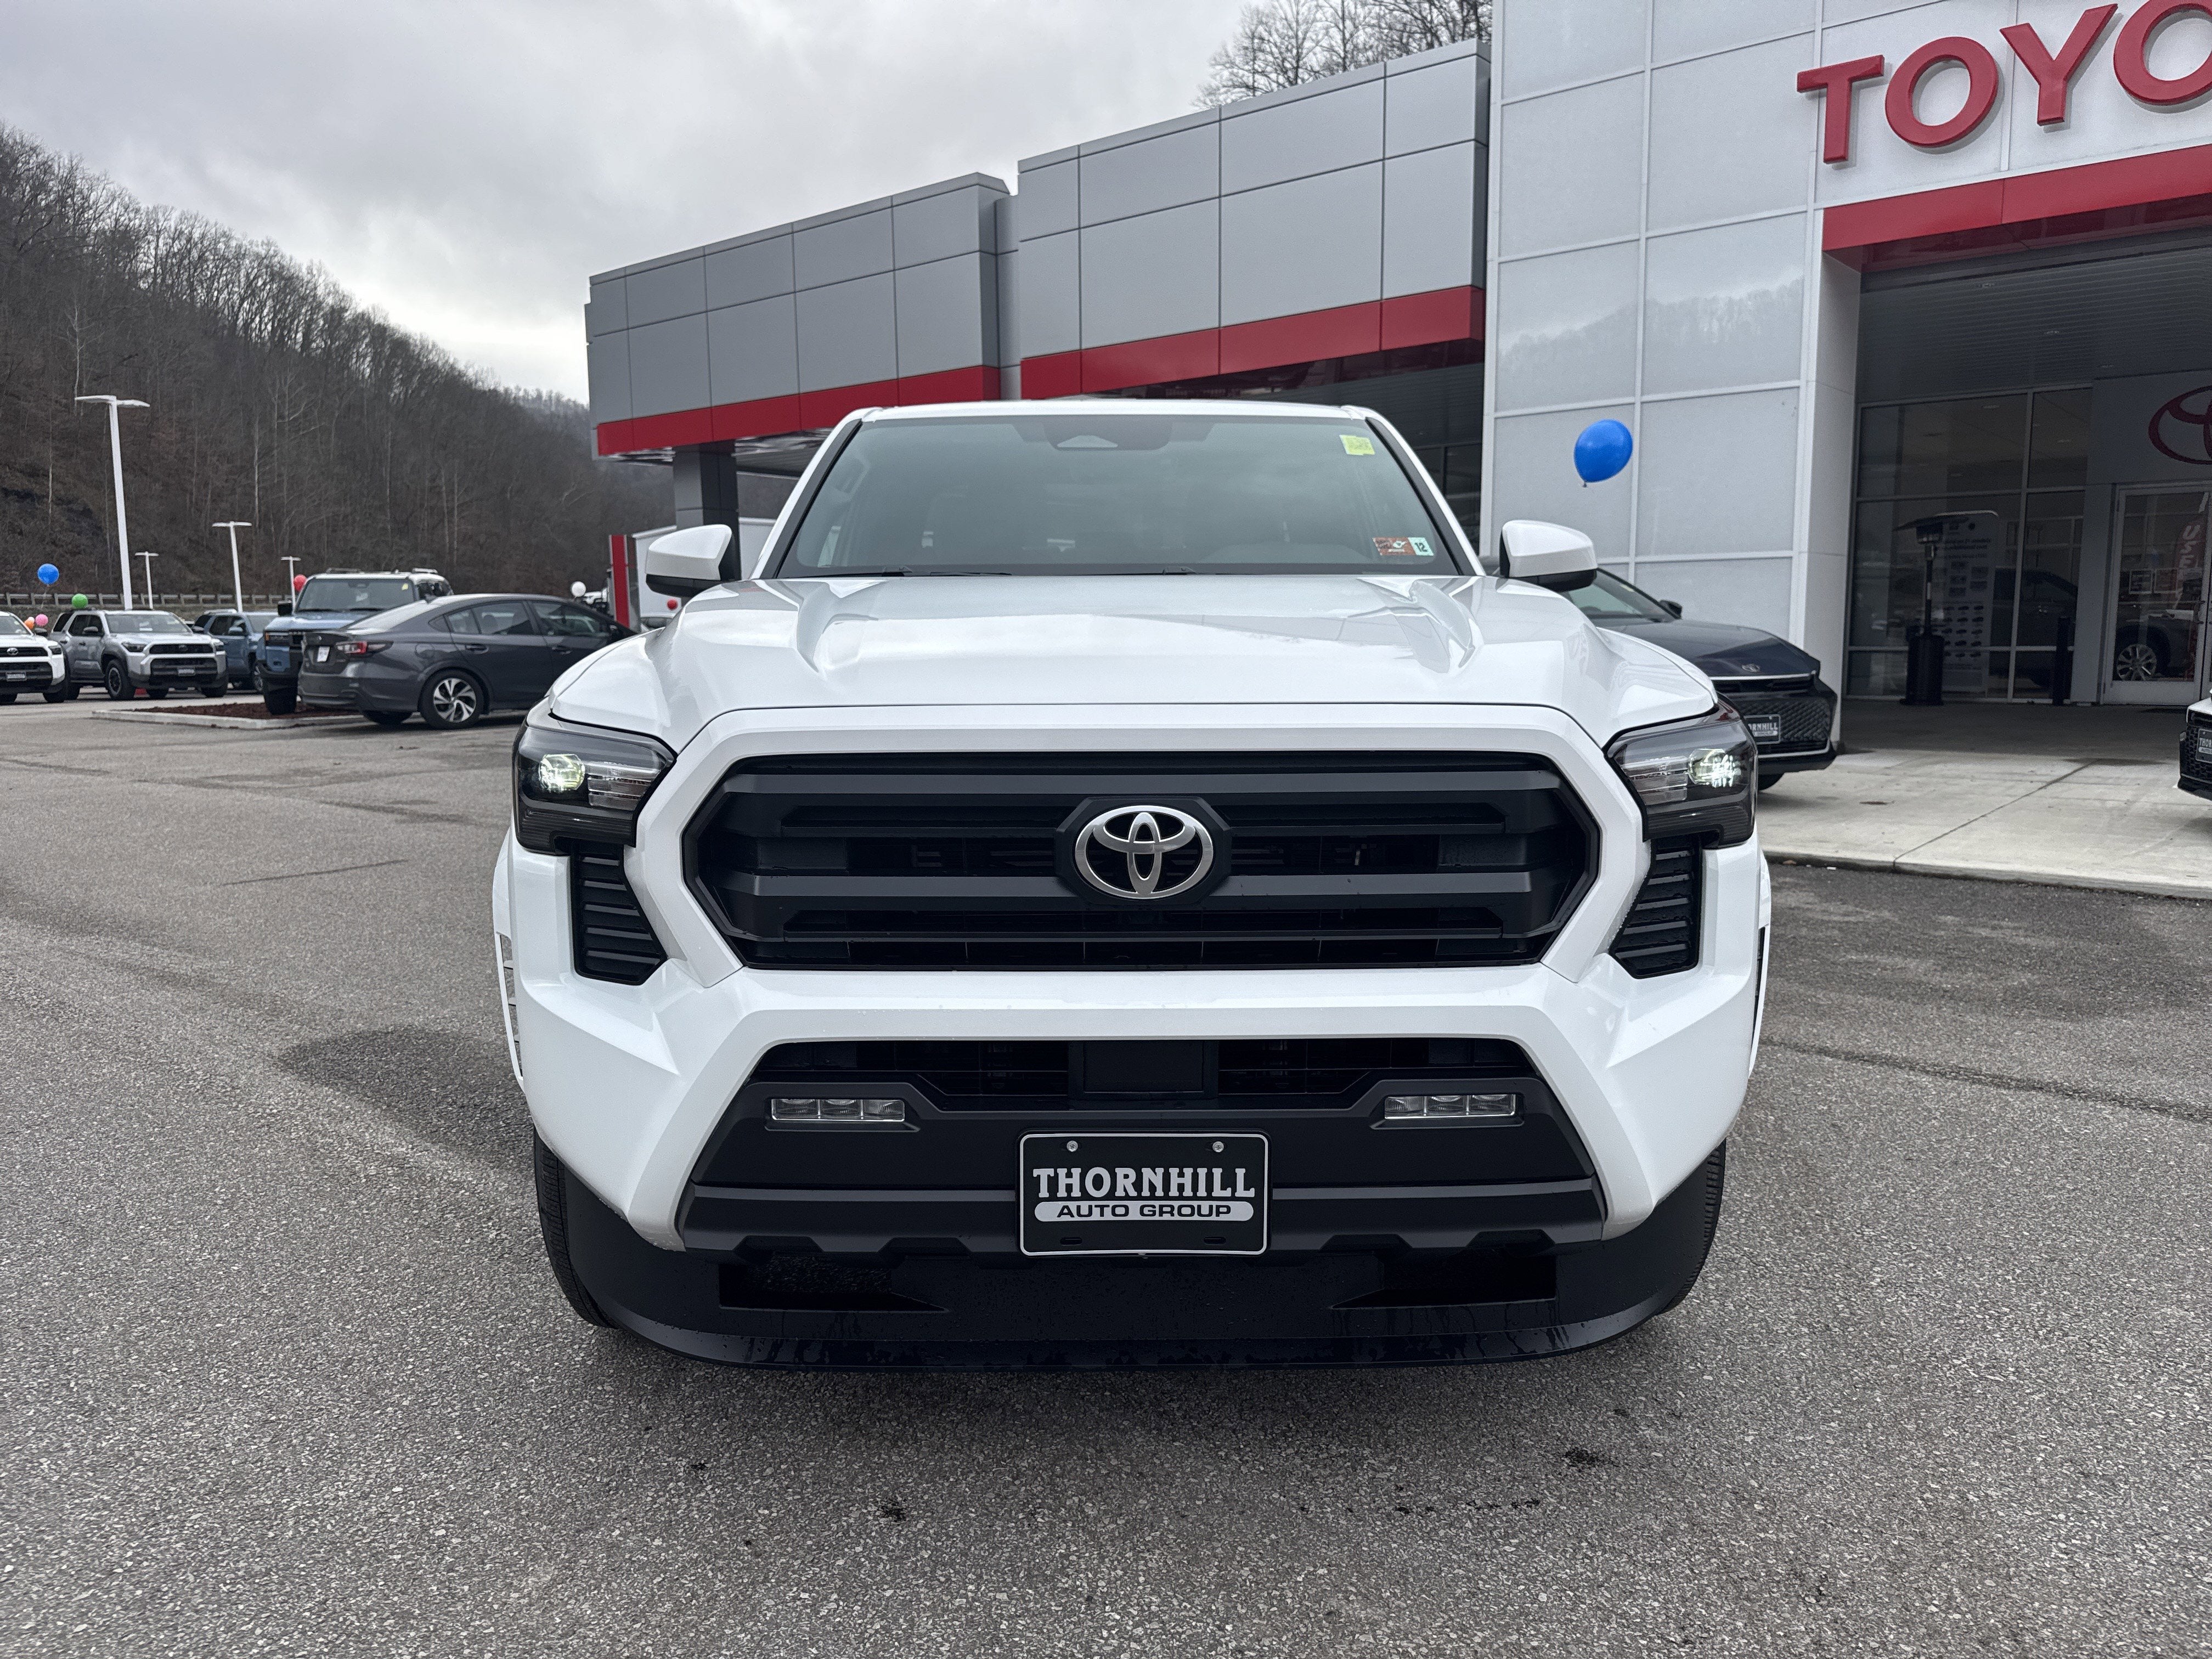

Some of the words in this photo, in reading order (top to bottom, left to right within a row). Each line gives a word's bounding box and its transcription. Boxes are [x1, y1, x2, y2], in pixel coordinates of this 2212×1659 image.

[1797, 0, 2212, 165] TOYO
[1414, 542, 1427, 552] 12
[1033, 1167, 1255, 1198] THORNHILL
[1057, 1205, 1130, 1218] AUTO
[1139, 1205, 1231, 1217] GROUP
